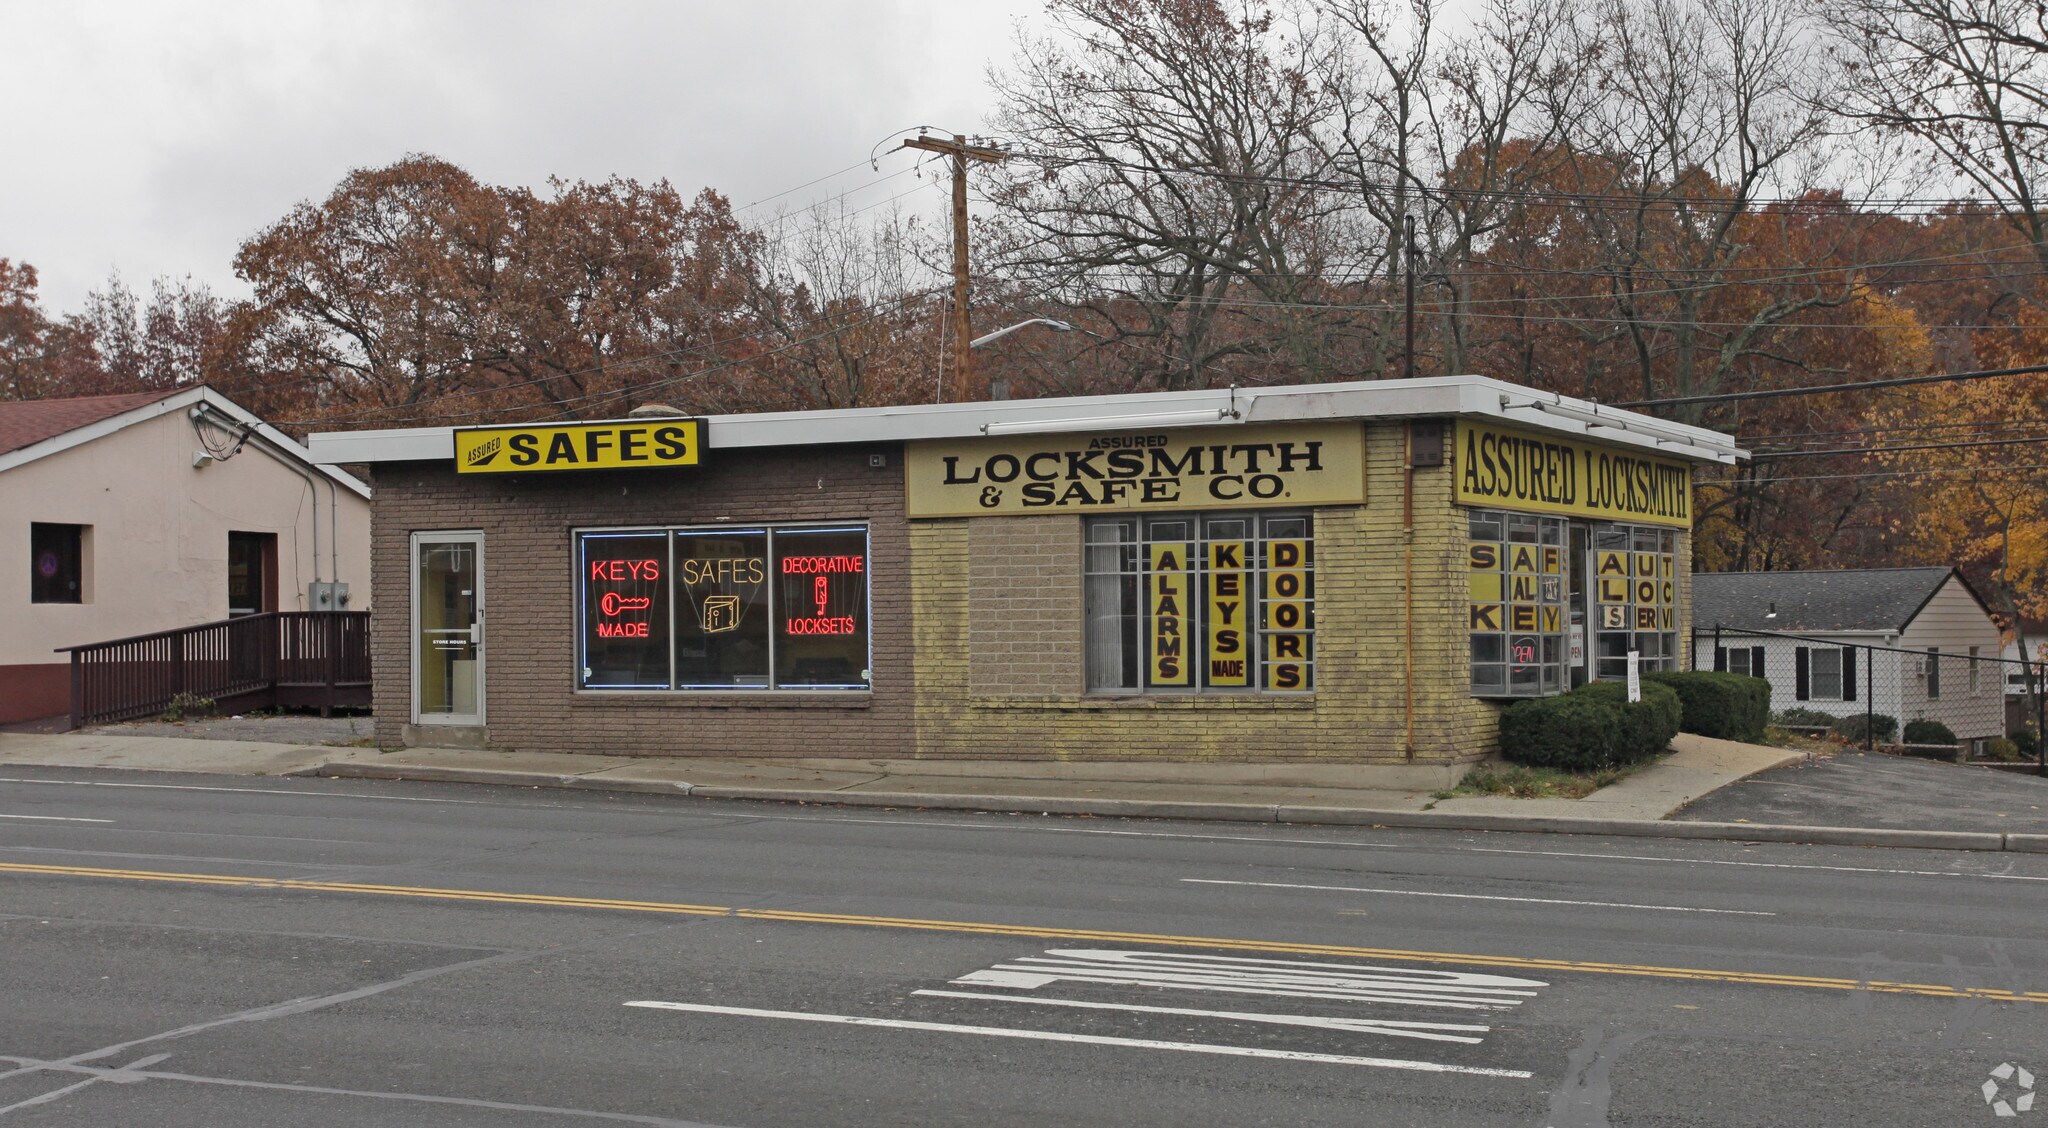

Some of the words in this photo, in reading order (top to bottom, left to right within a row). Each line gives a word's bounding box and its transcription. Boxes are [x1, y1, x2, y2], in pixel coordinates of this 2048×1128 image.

[467, 437, 502, 464] ASSURED
[509, 427, 687, 466] SAFES
[1089, 435, 1168, 450] ASSURED
[943, 441, 1324, 485] LOCKSMITH
[1463, 429, 1576, 505] ASSURED
[1585, 450, 1687, 519] LOCKSMITH
[979, 486, 1003, 508] &
[1022, 477, 1180, 507] SAFE
[1209, 474, 1291, 500] CO.
[592, 559, 660, 581] KEYS
[684, 558, 764, 585] SAFES
[783, 555, 864, 574] DECORATIVE
[599, 623, 649, 637] MADE
[788, 617, 855, 635] LOCKSETS
[1571, 646, 1582, 658] PEN
[1212, 660, 1244, 678] MADE
